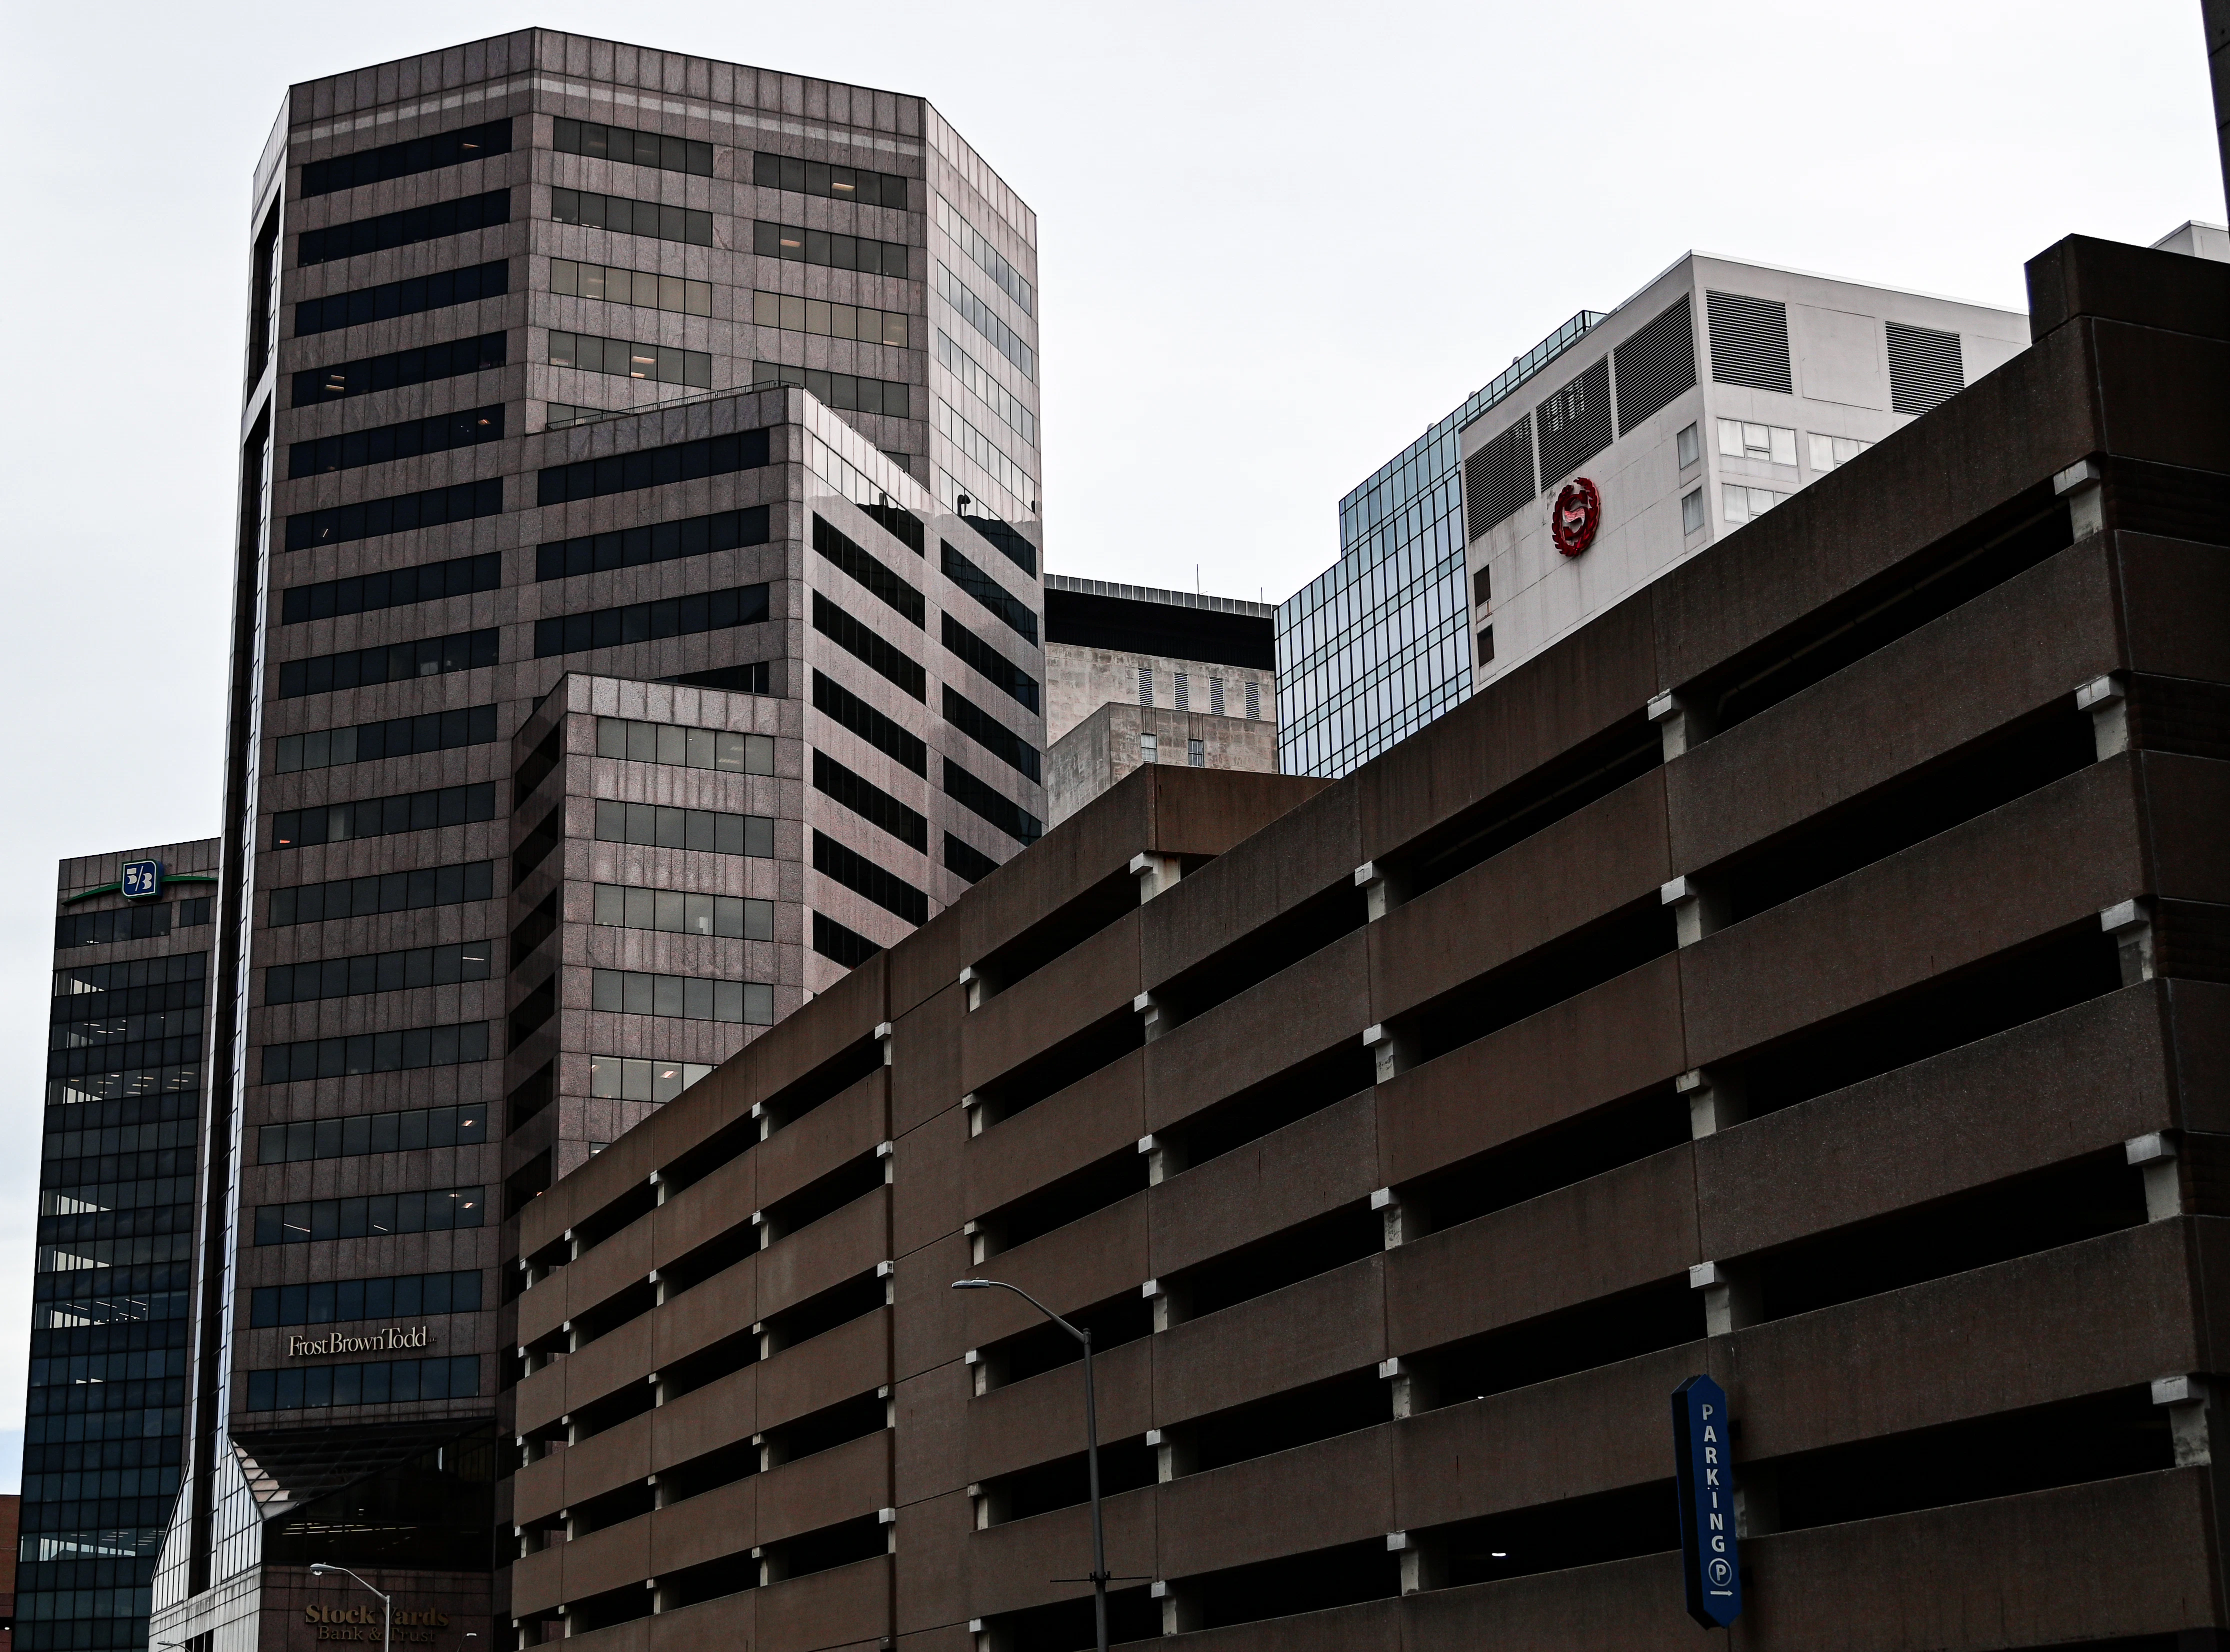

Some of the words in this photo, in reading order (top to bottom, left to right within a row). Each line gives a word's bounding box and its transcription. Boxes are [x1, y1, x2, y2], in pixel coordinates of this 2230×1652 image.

[126, 865, 152, 892] 5/3
[288, 1335, 328, 1357] Frost
[330, 1332, 384, 1353] Brown
[381, 1326, 426, 1349] Todd
[1702, 1404, 1725, 1553] PARKING
[306, 1604, 376, 1624] Stock
[318, 1626, 364, 1640] Bank
[368, 1627, 382, 1641] &
[389, 1628, 436, 1642] Trust
